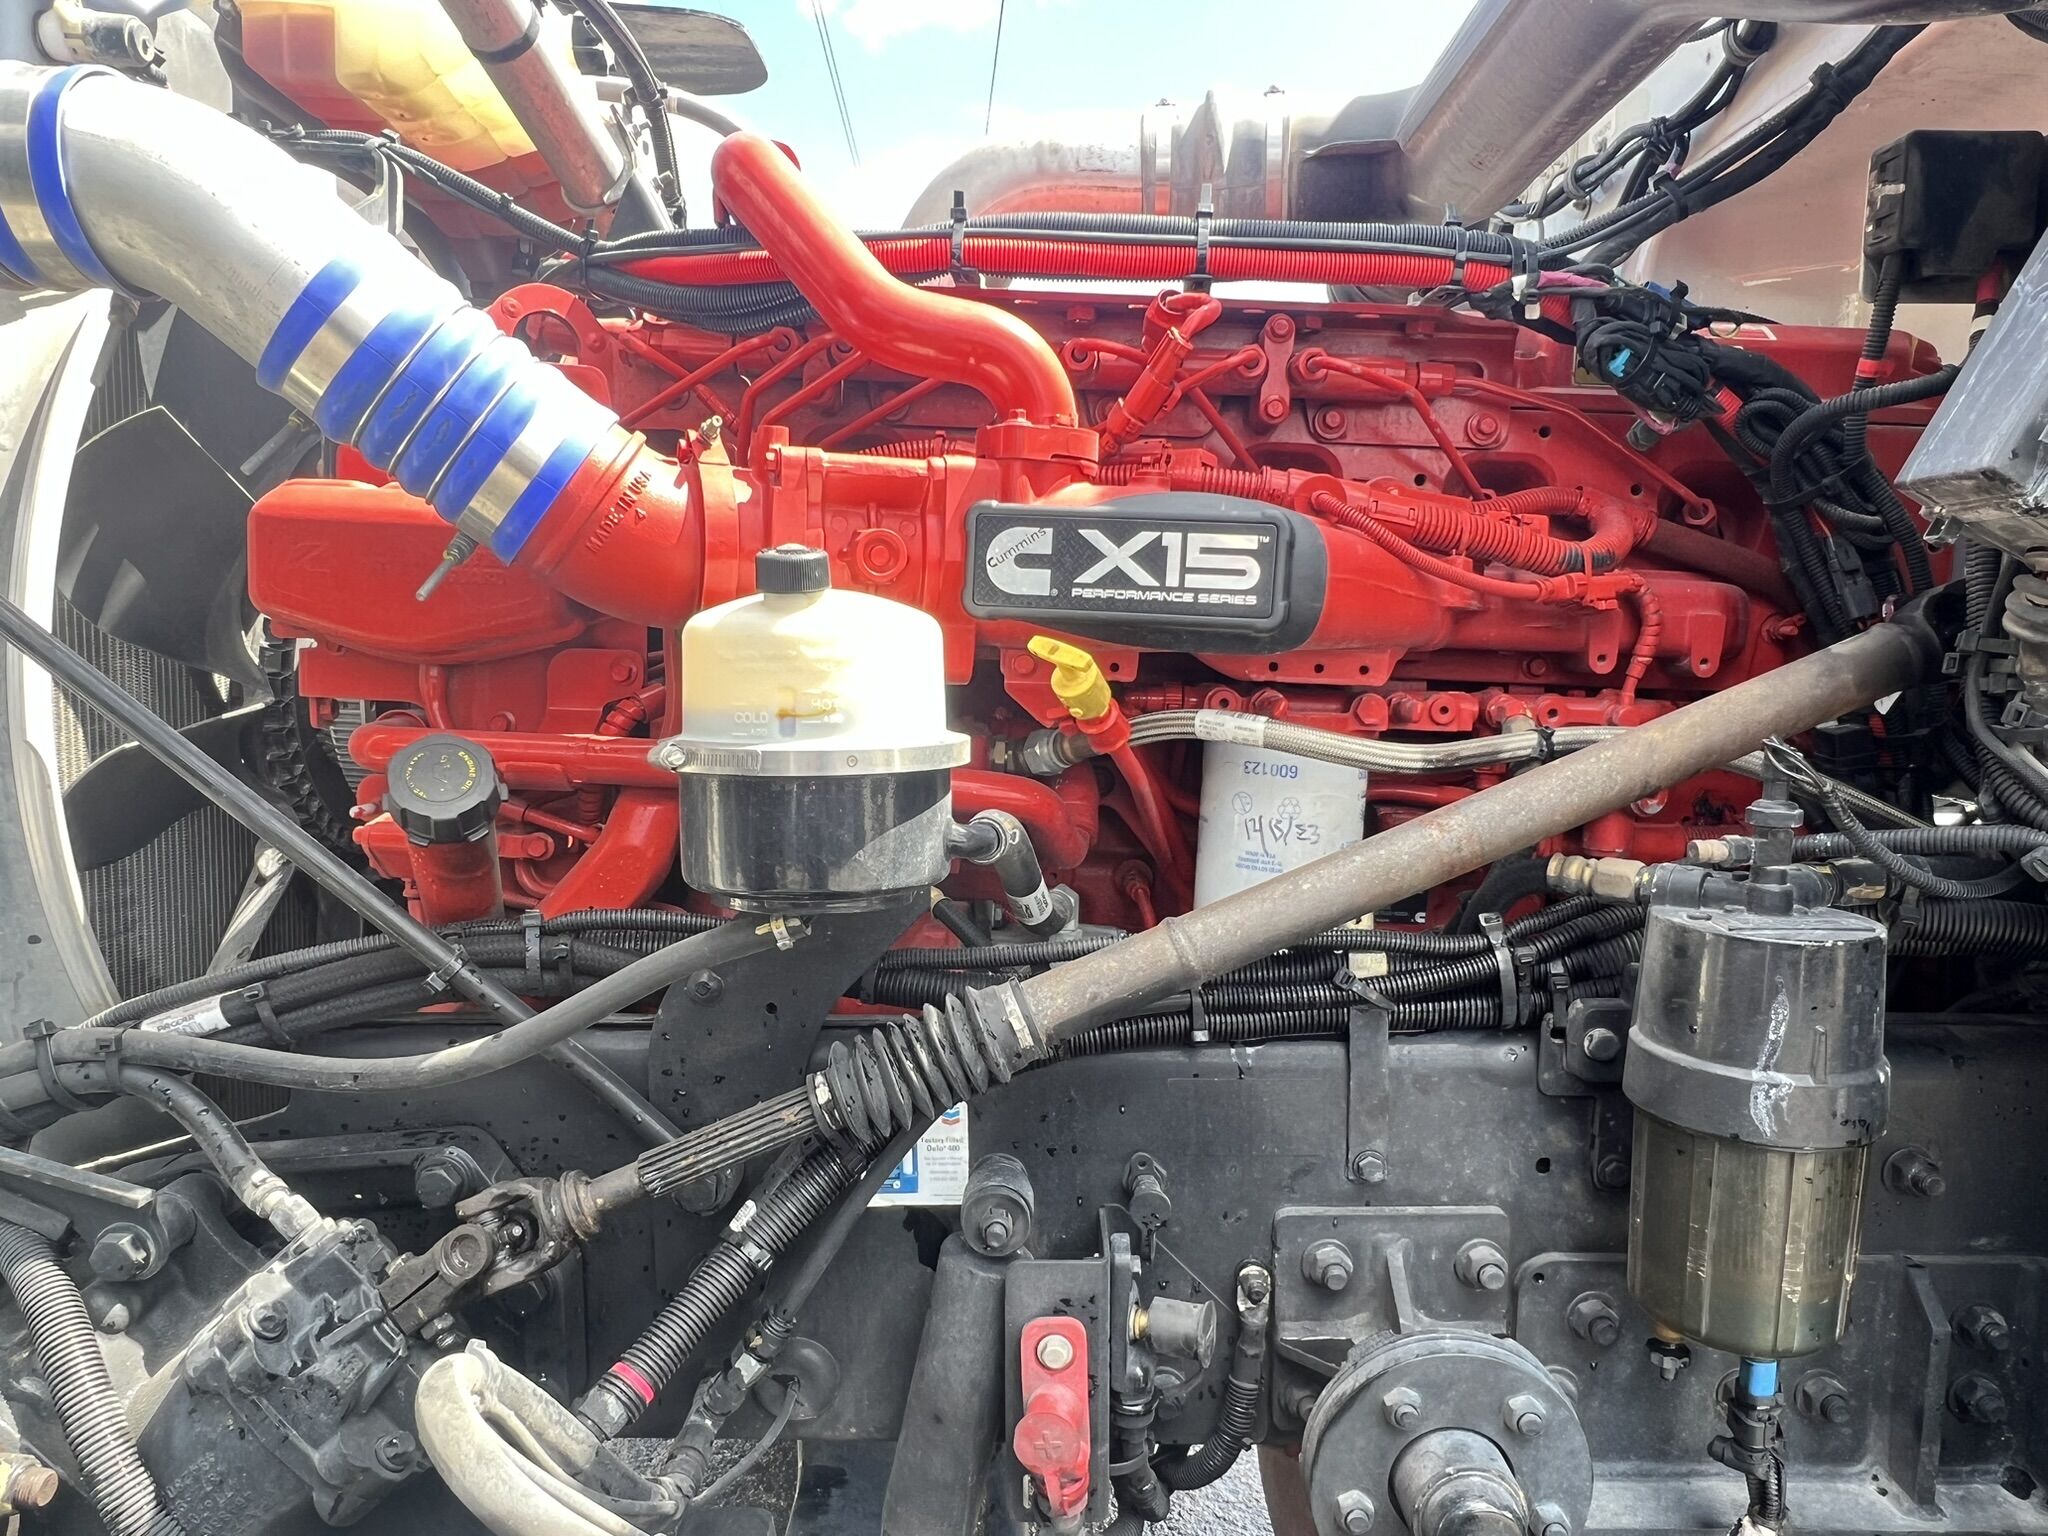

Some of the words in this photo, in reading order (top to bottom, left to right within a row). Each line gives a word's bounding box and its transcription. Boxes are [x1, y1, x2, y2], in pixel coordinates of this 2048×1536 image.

[987, 527, 1047, 569] Cummins
[1071, 588, 1195, 603] PERFORMANCE
[1197, 594, 1257, 605] SERIES
[734, 711, 769, 724] COLD
